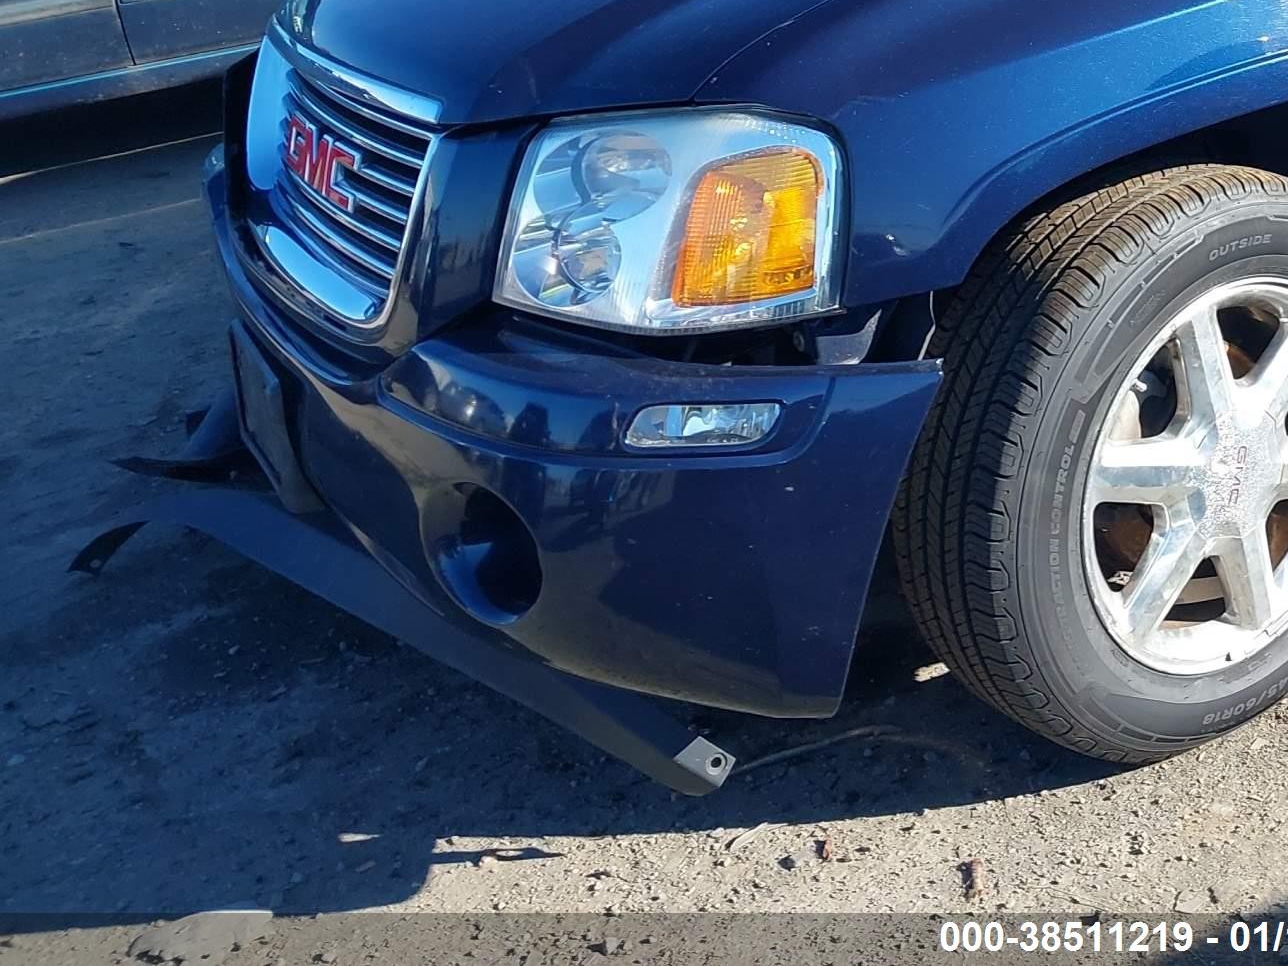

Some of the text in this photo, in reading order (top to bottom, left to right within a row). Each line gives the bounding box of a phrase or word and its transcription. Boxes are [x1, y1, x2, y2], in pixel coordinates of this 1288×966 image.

[286, 111, 362, 214] GMC
[1208, 234, 1273, 261] OUTSIDE
[1053, 445, 1076, 534] CONTROL
[1228, 445, 1248, 507] GMC
